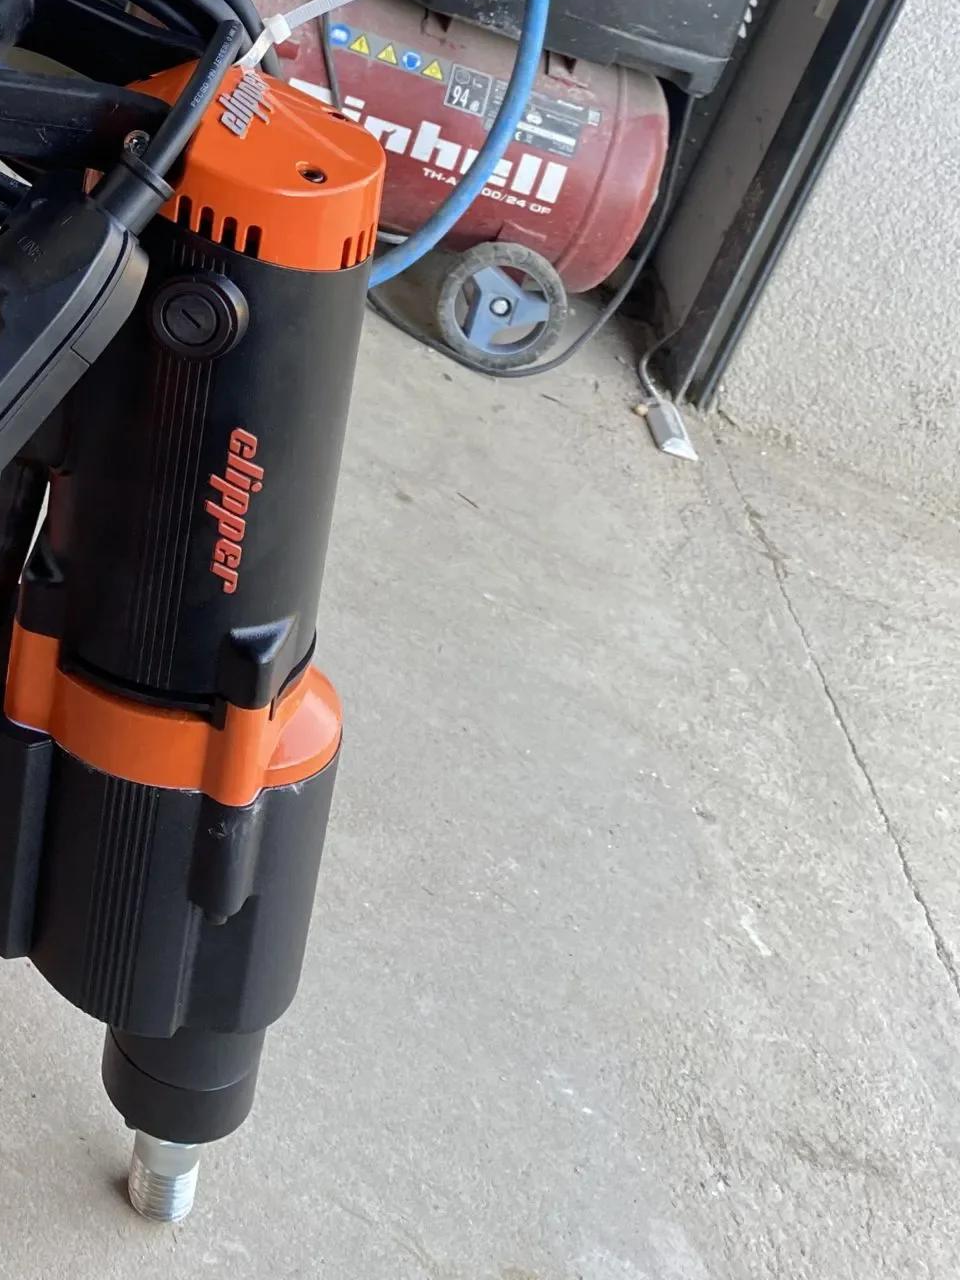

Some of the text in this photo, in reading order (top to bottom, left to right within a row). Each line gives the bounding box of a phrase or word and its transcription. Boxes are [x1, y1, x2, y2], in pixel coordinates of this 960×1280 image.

[289, 77, 568, 204] inhell
[452, 85, 469, 108] 94
[422, 167, 552, 216] TH-A 00/24 OF
[205, 427, 265, 594] clipper
